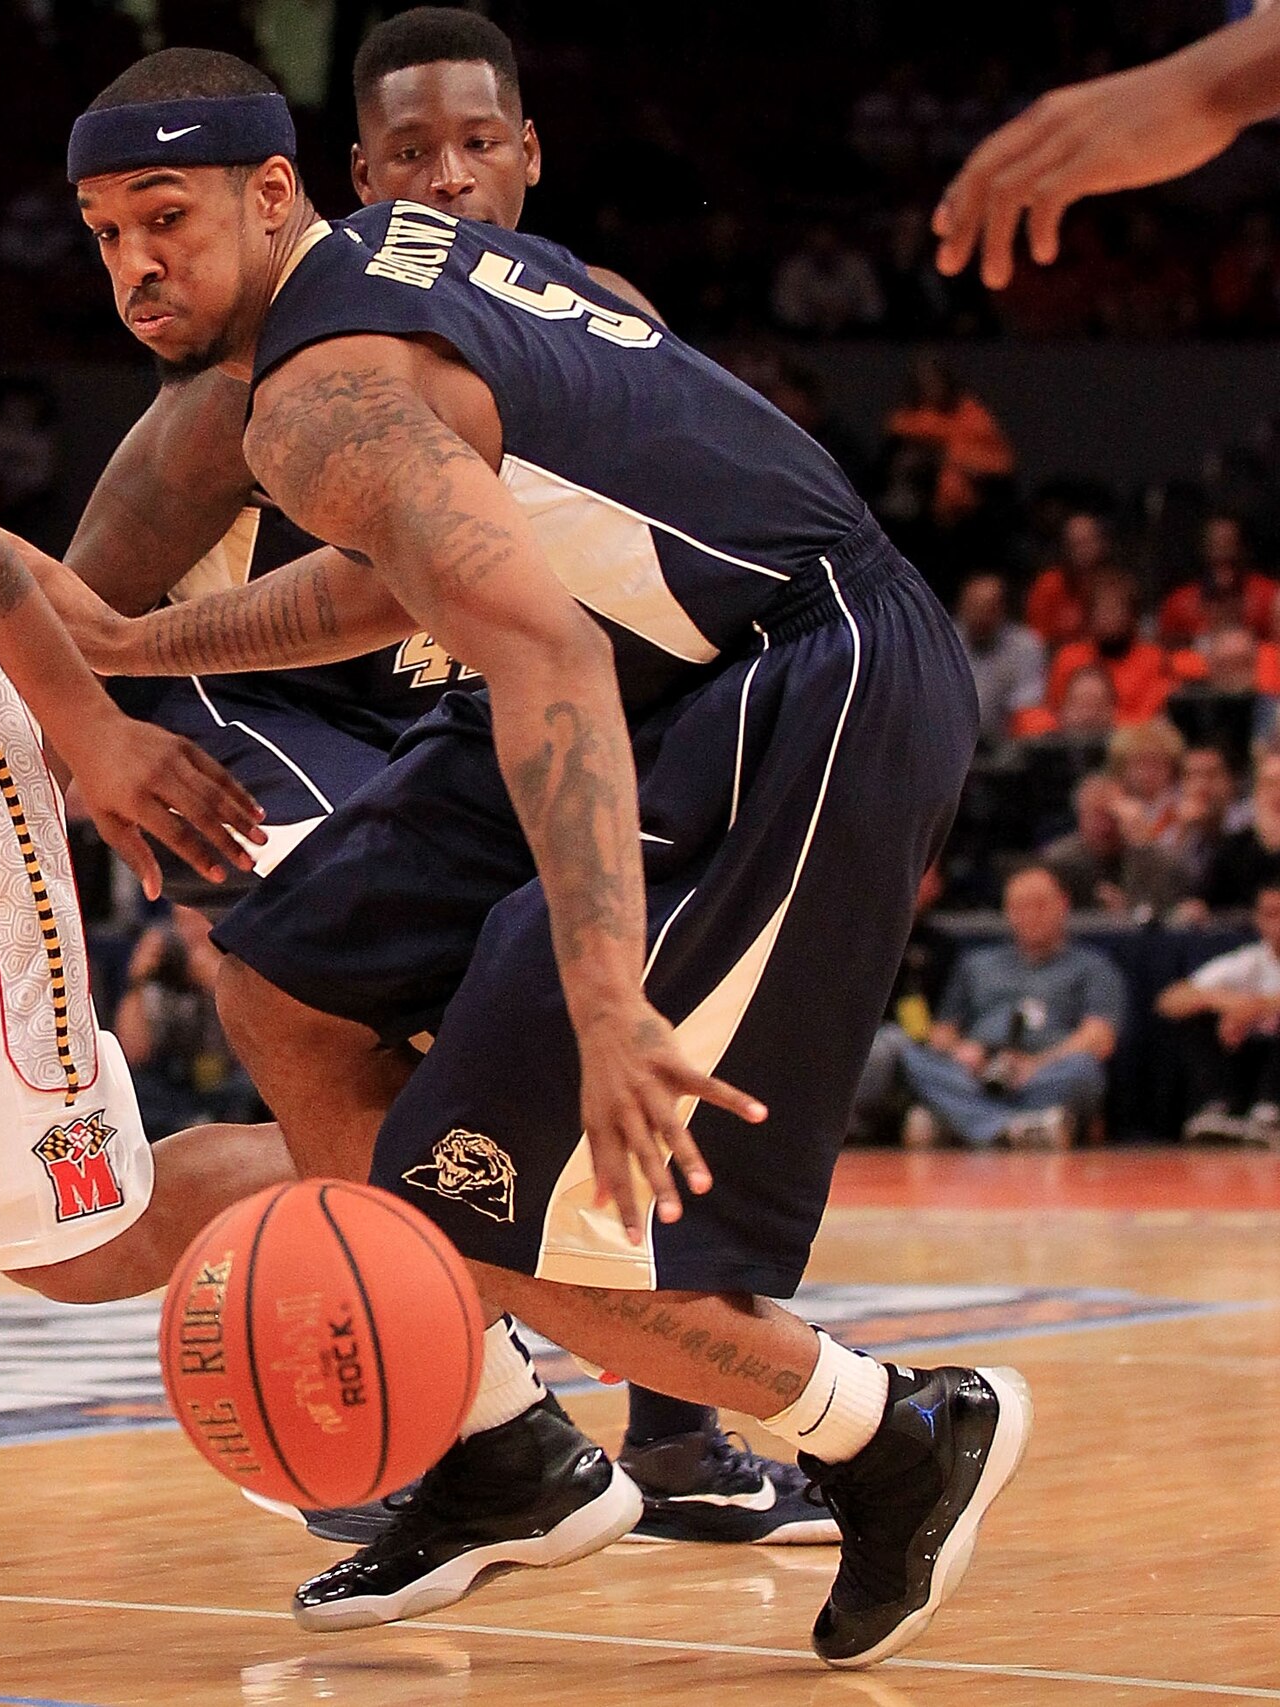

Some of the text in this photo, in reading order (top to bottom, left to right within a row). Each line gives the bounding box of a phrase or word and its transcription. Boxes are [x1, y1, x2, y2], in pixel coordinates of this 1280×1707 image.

[468, 250, 664, 349] 5
[44, 1151, 124, 1223] M
[181, 1255, 261, 1474] THE ROCK
[329, 1318, 366, 1406] ROCK
